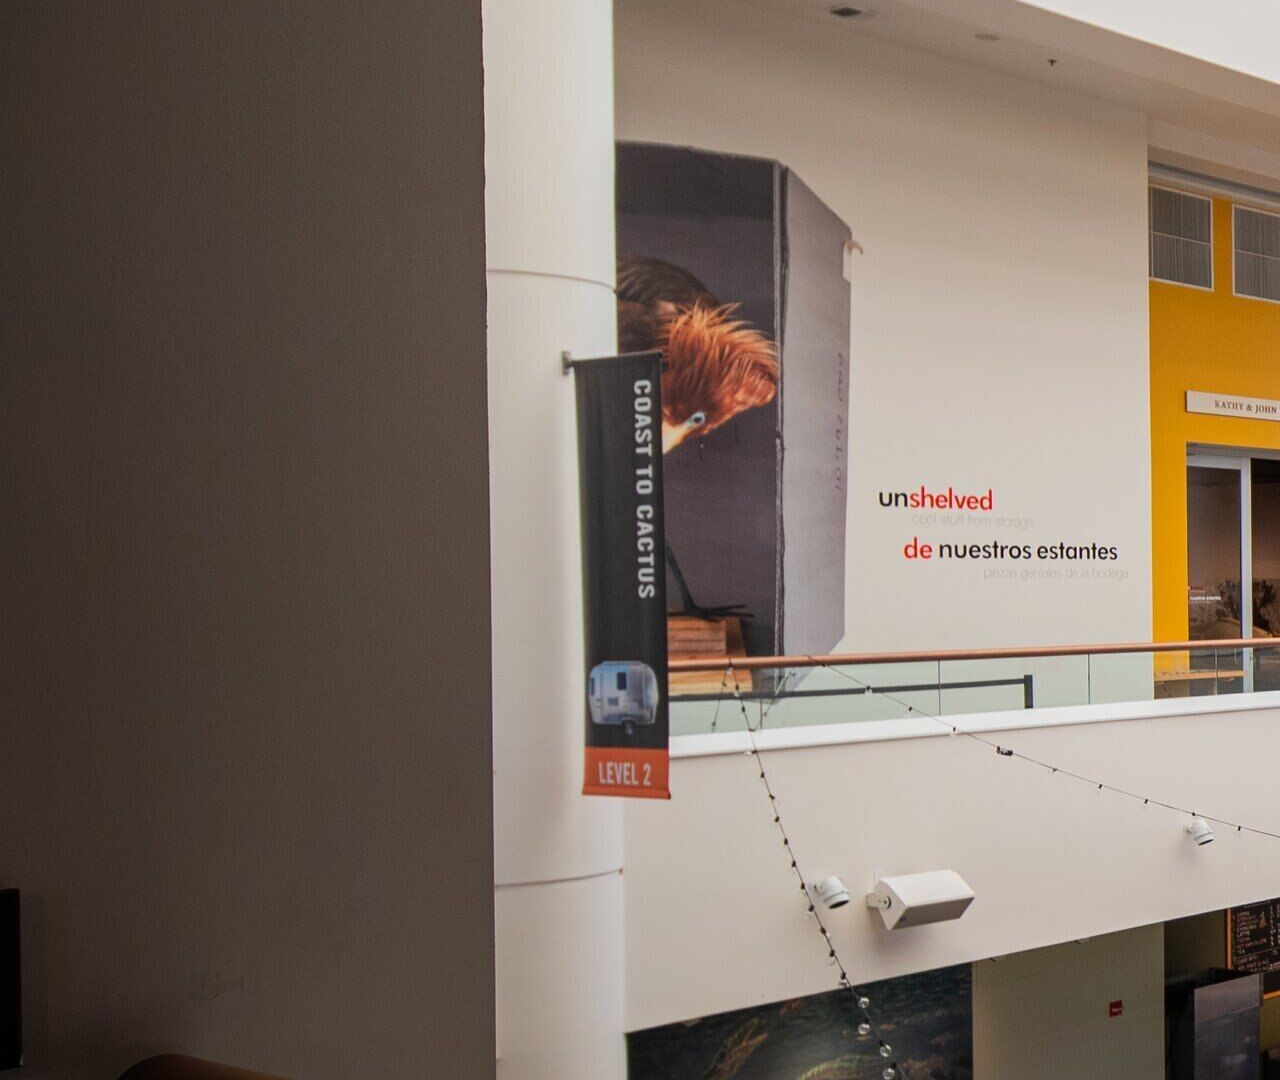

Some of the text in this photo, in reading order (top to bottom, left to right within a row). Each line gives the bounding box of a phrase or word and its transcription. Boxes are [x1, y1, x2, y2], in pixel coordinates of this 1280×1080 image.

[1214, 400, 1244, 411] KATHY
[1255, 404, 1277, 415] JOHN
[634, 380, 655, 599] COAST TO CACTUS
[878, 486, 993, 510] unshelved
[903, 537, 1118, 560] de nuestros estantes
[598, 761, 652, 786] LEVEL 2
